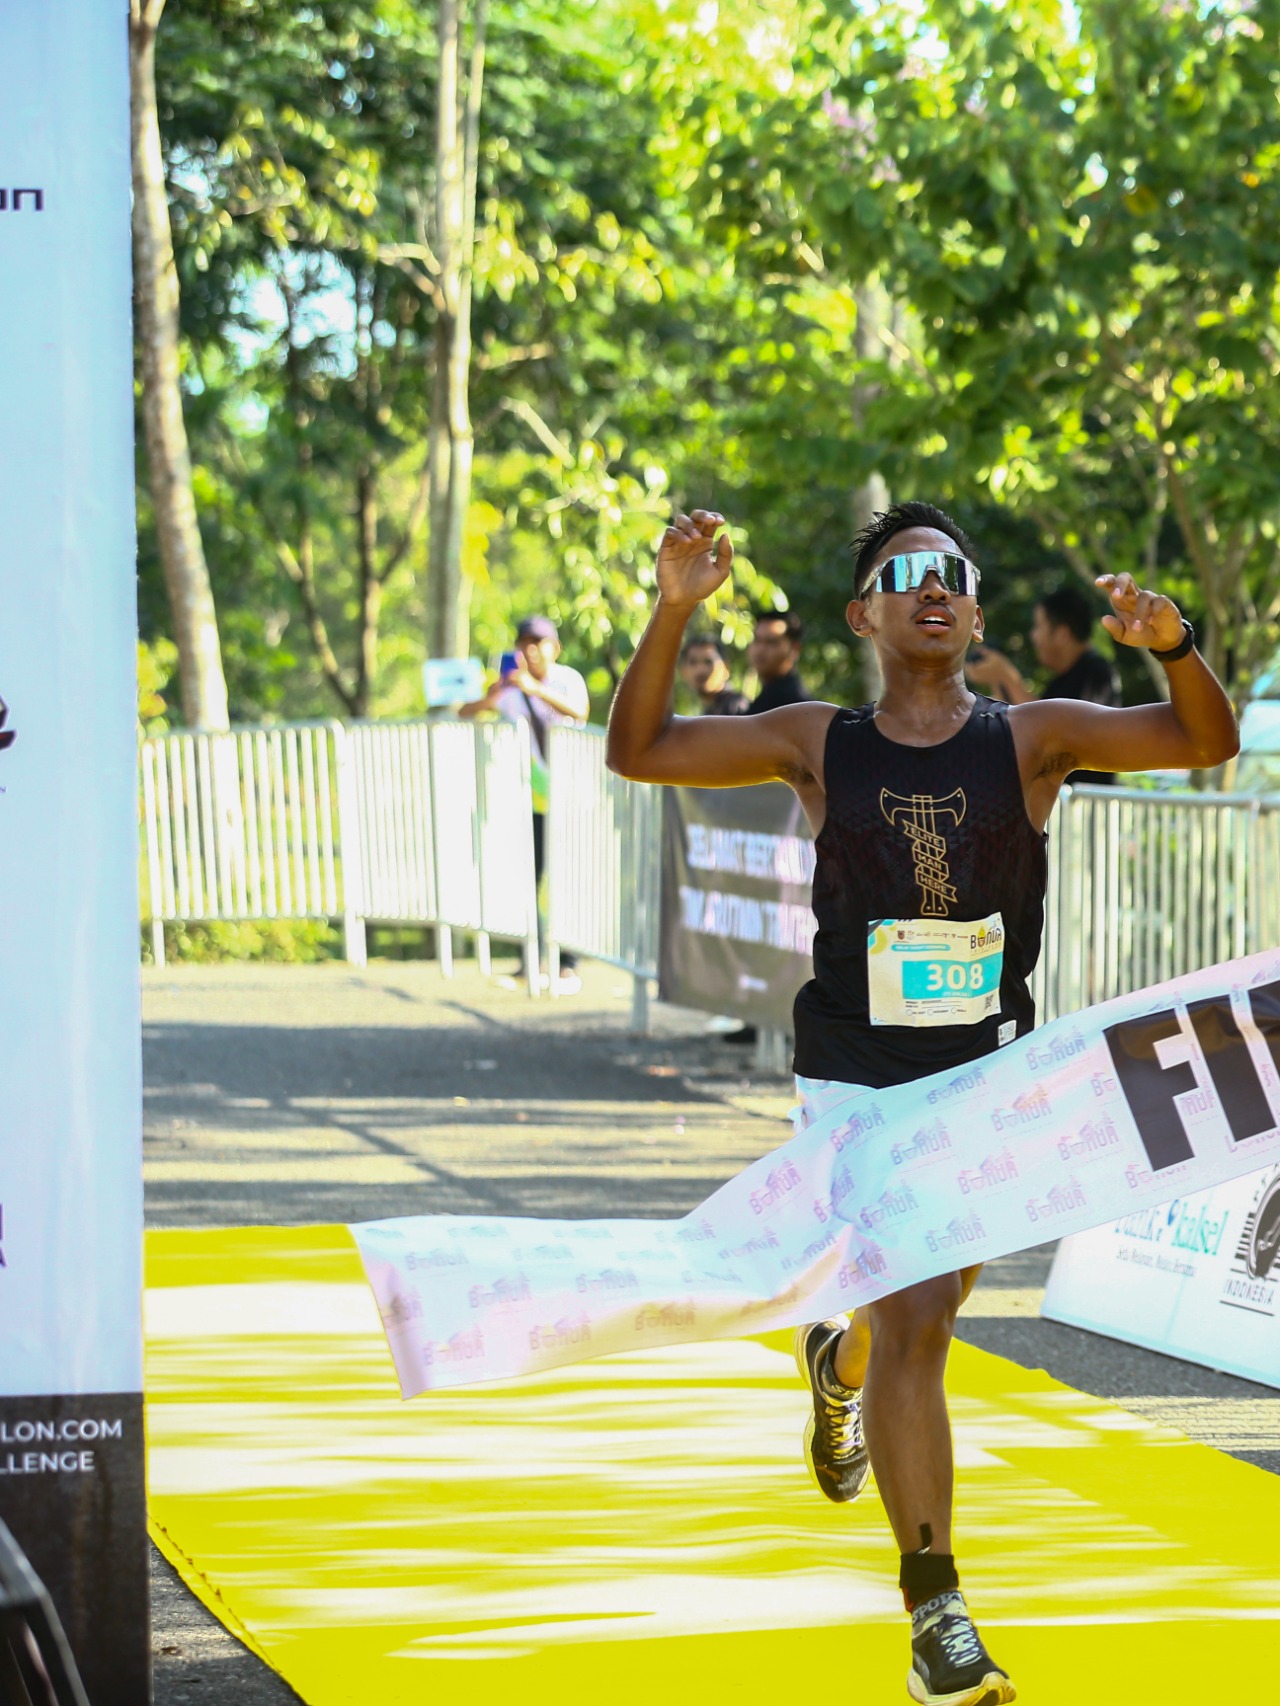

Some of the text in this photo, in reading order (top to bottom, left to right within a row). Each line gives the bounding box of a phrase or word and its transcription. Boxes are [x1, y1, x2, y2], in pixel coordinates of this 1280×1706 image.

[910, 826, 941, 847] ELITE
[917, 853, 942, 871] MAN
[920, 874, 948, 895] HERE
[926, 963, 985, 991] 308
[1223, 1278, 1276, 1306] INDONESIA
